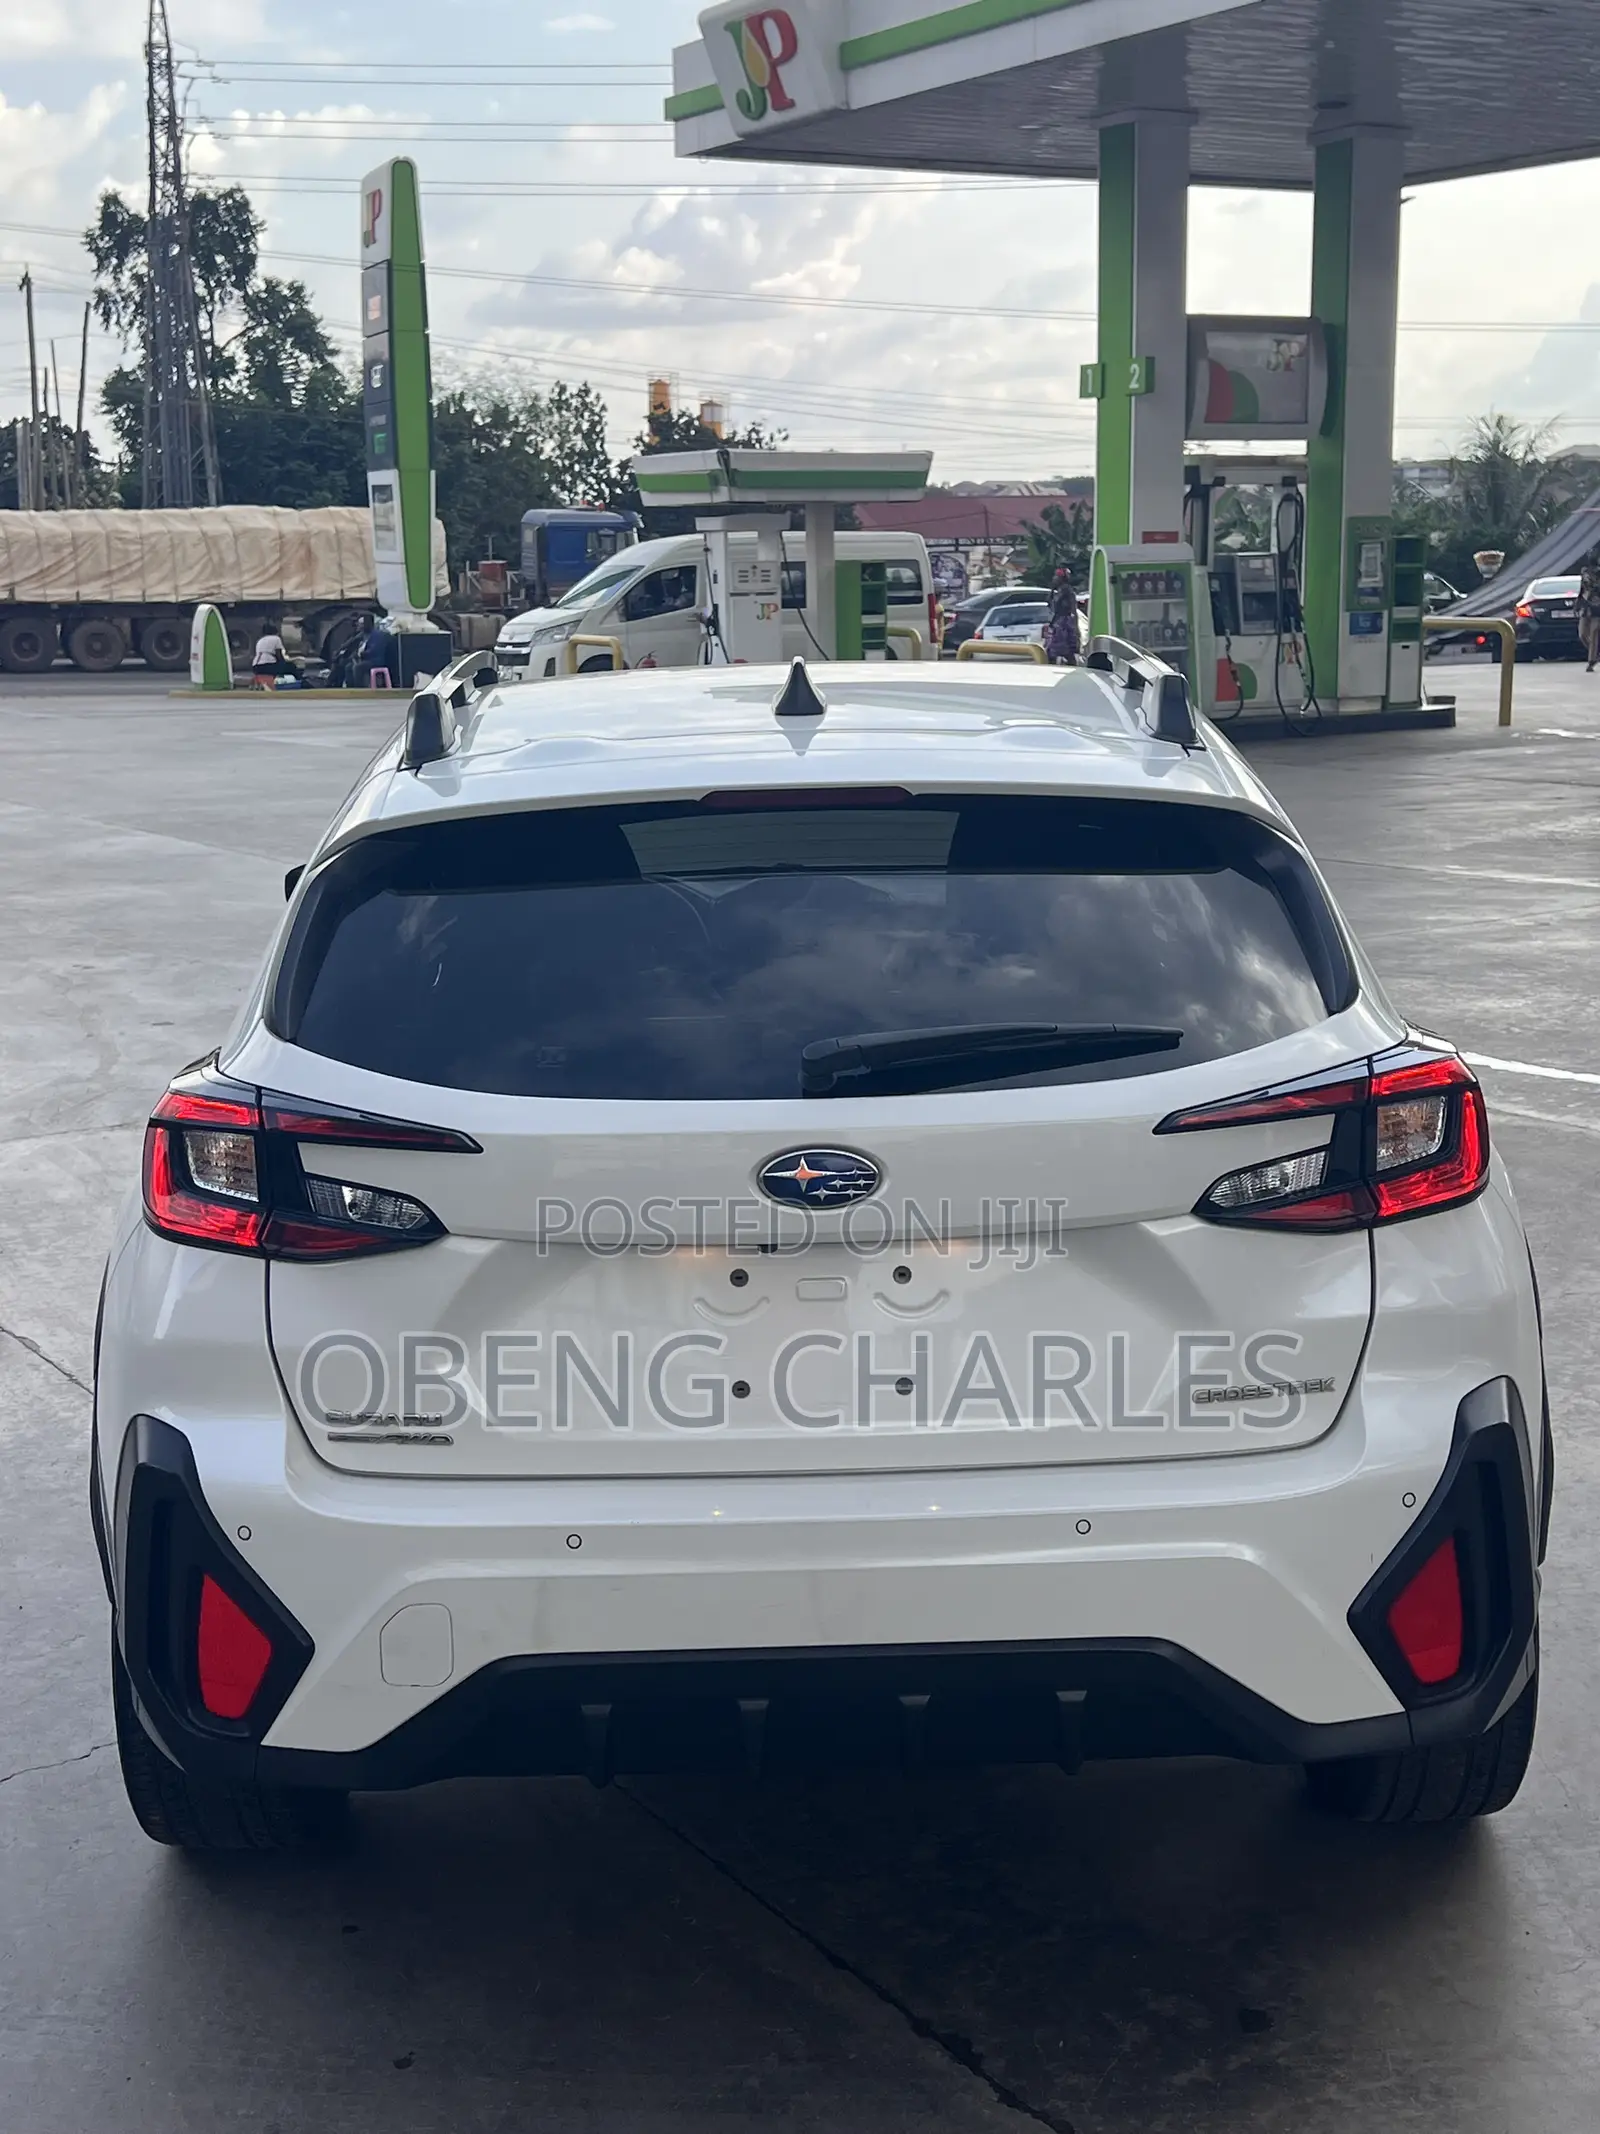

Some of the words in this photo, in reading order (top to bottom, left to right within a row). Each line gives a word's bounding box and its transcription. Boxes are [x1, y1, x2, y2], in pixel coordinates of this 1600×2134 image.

[723, 8, 799, 121] JP
[1086, 368, 1093, 393] 1
[1129, 363, 1140, 389] 2
[756, 603, 779, 621] JP
[1192, 1377, 1335, 1405] CROSSTREK
[326, 1409, 443, 1427] SUBARU
